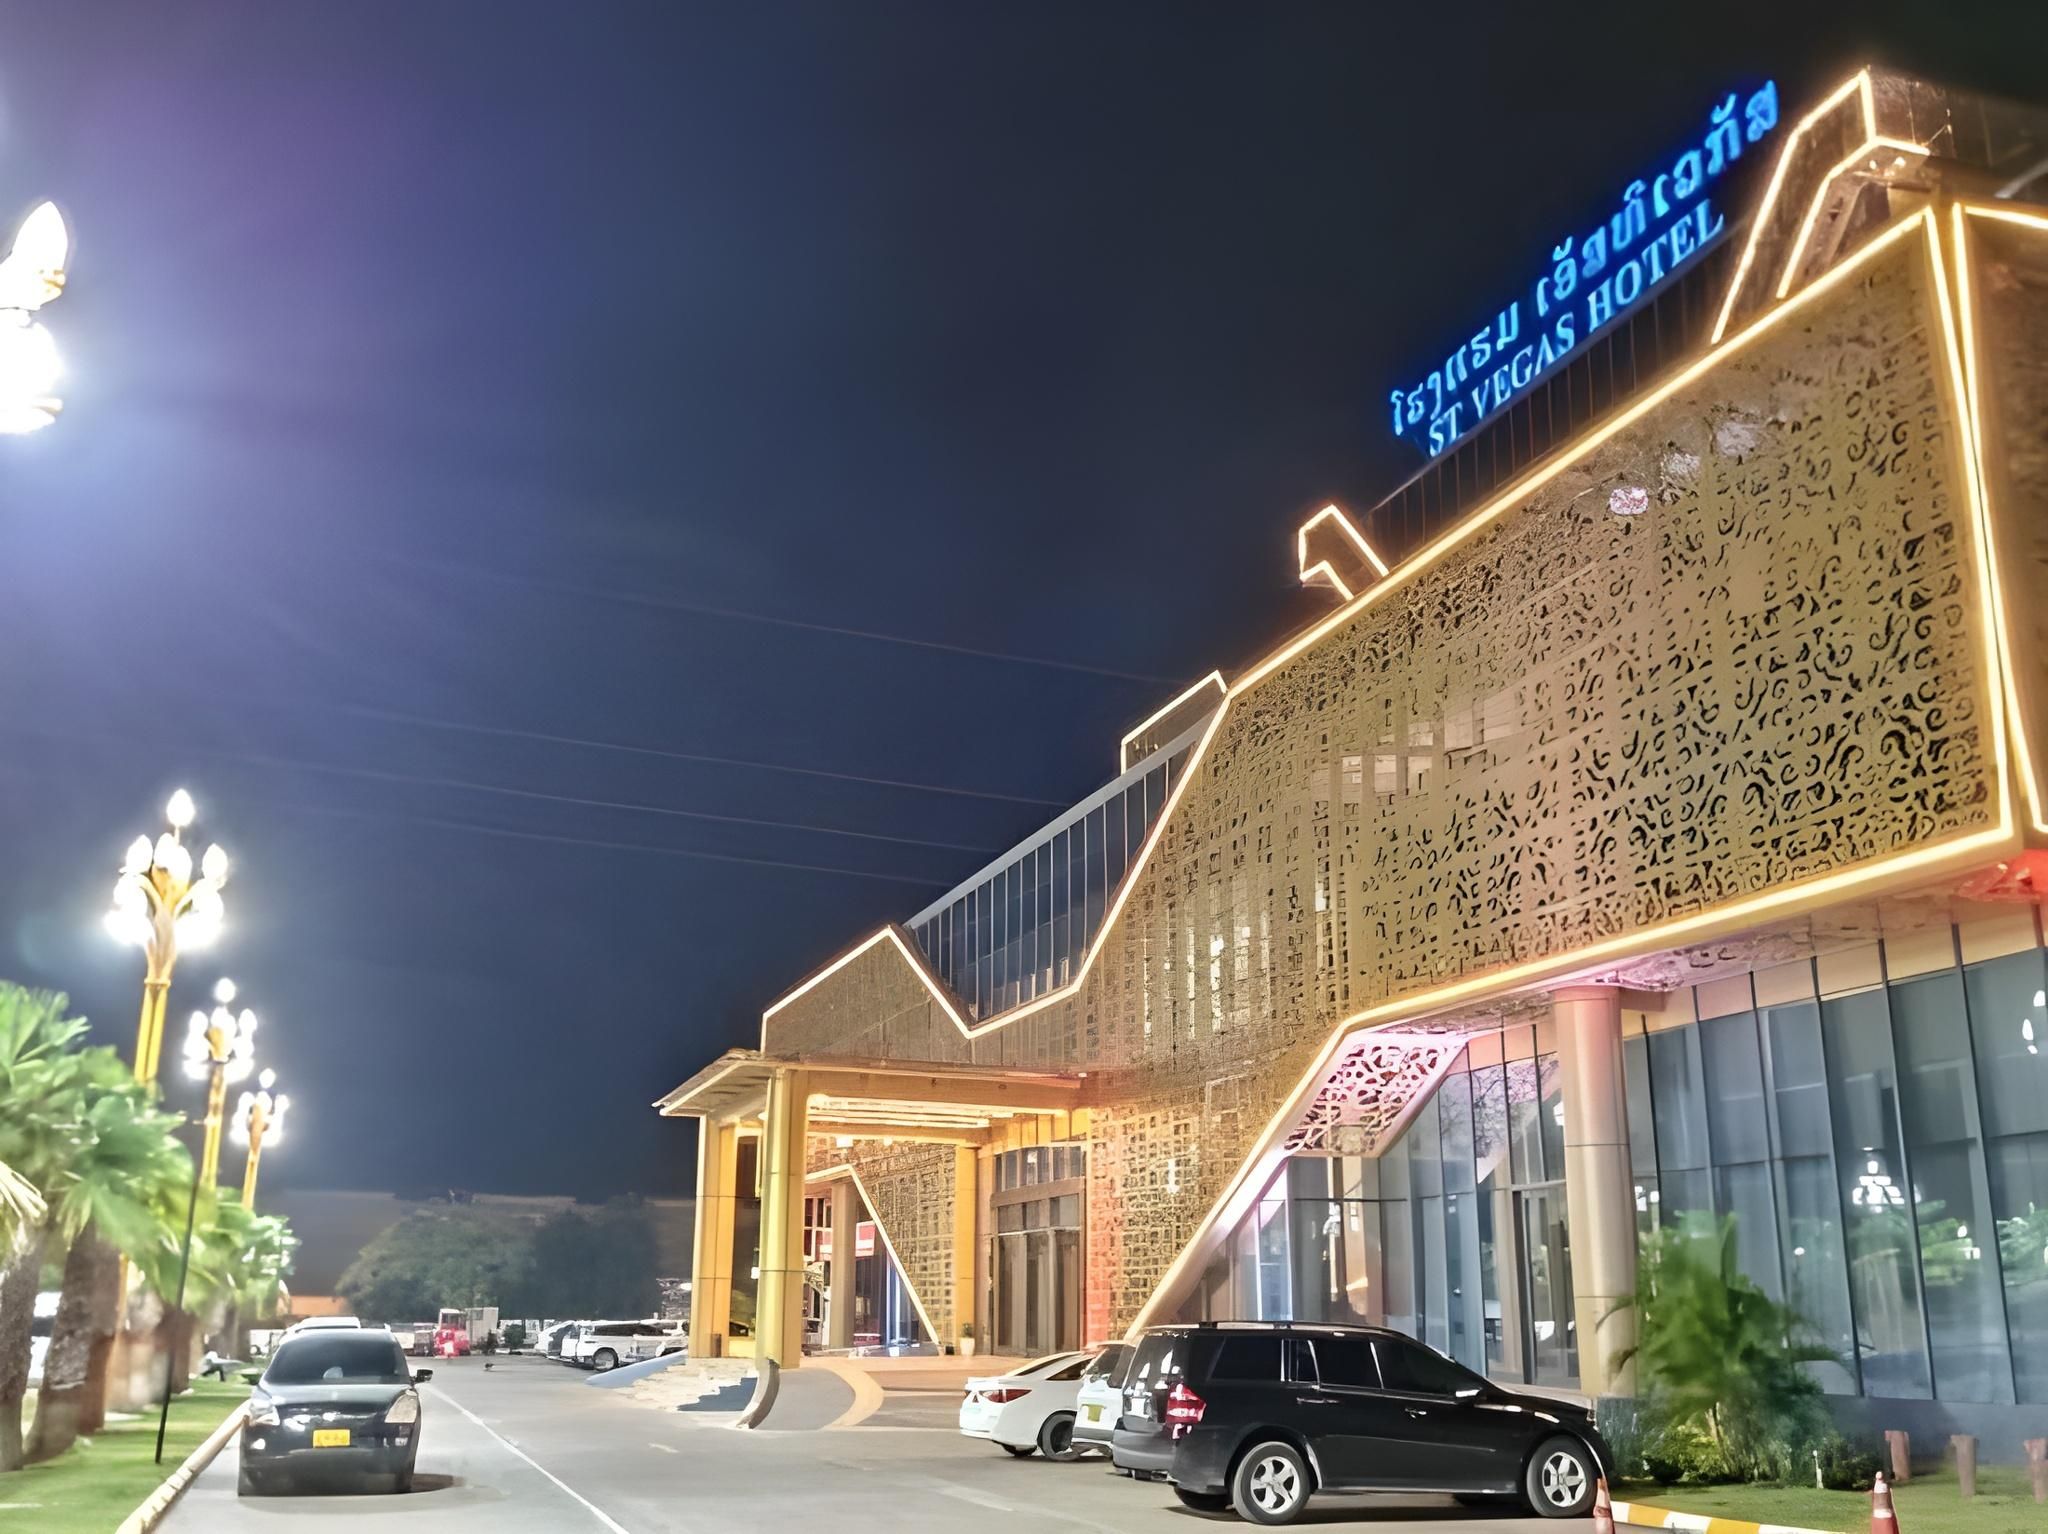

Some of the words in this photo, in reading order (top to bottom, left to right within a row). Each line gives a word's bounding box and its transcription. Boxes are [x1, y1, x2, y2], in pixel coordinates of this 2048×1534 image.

[1428, 401, 1466, 458] ST
[1471, 312, 1576, 419] VEGAS
[1587, 198, 1725, 333] HOTEL
